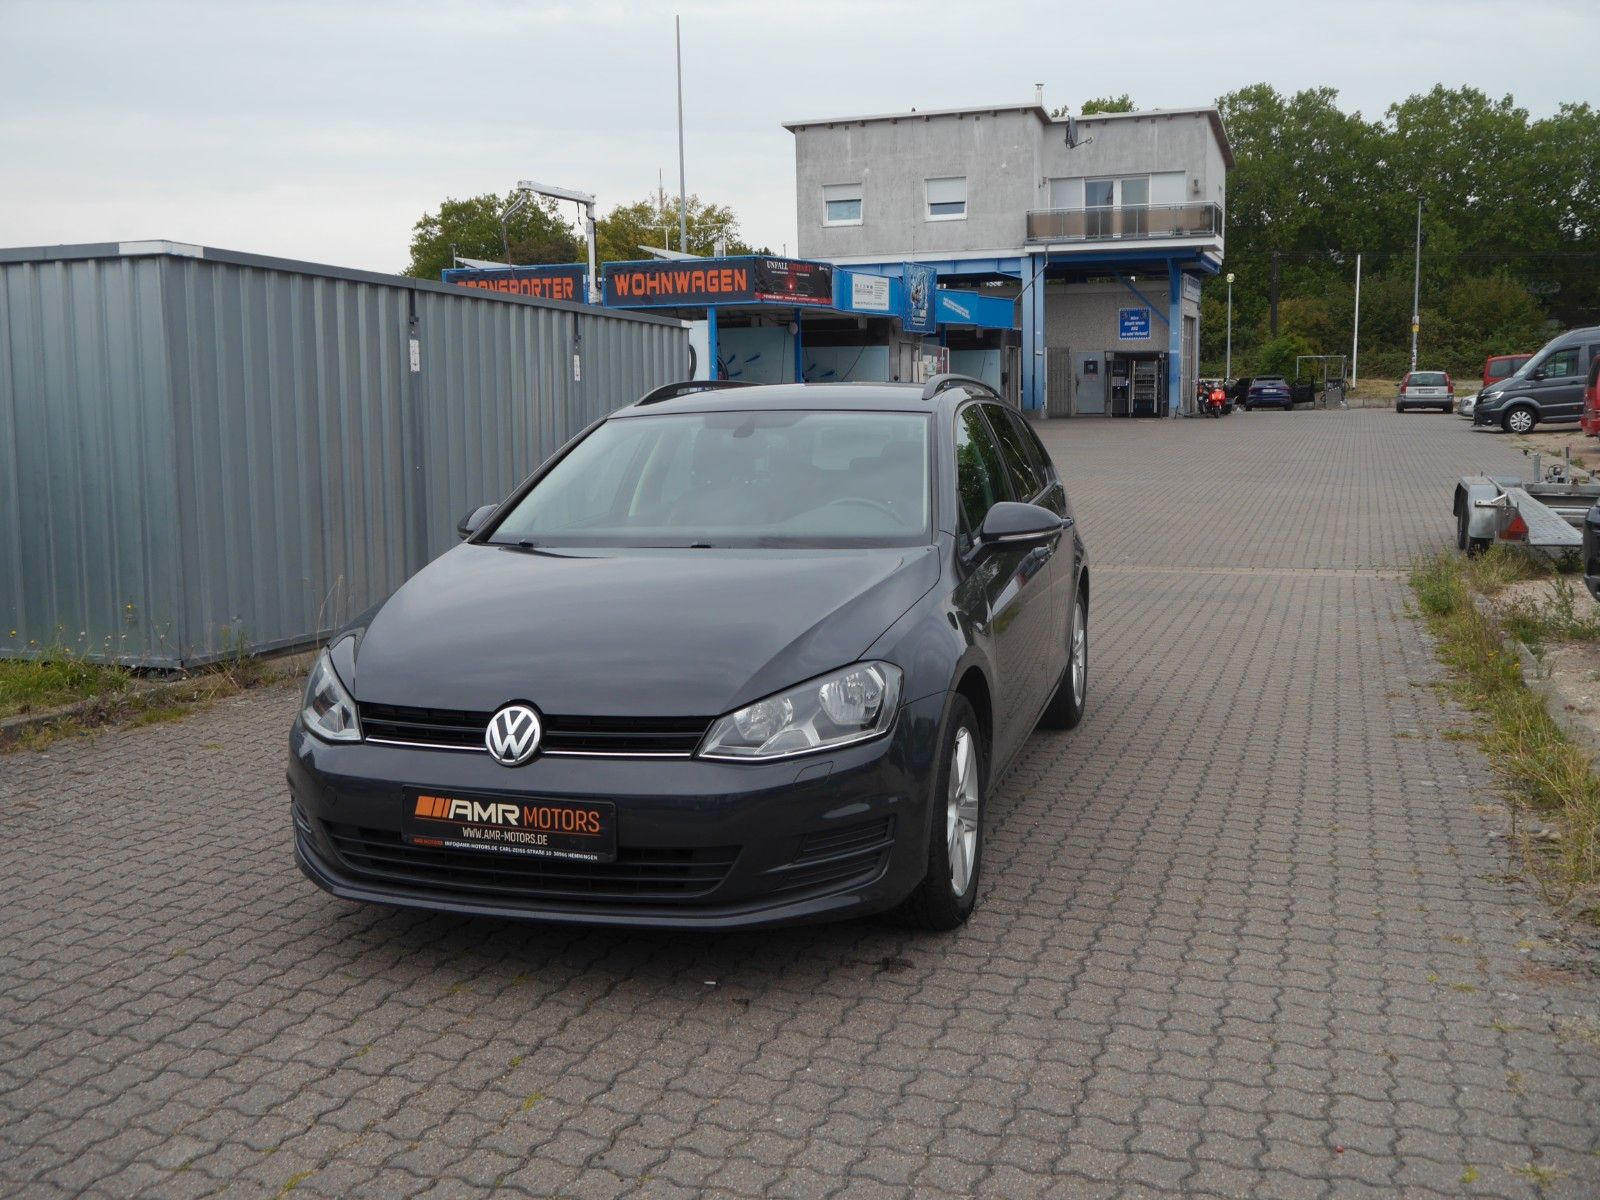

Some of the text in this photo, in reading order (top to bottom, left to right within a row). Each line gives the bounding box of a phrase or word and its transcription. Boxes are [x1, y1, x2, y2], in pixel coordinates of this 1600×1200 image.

[766, 260, 788, 270] UNFALL
[457, 277, 573, 299] NSPORTER
[614, 269, 747, 297] WOHNWAGEN
[448, 799, 600, 832] AMR MOTORS
[462, 827, 548, 845] WWW.AMR-MOTORS.DE
